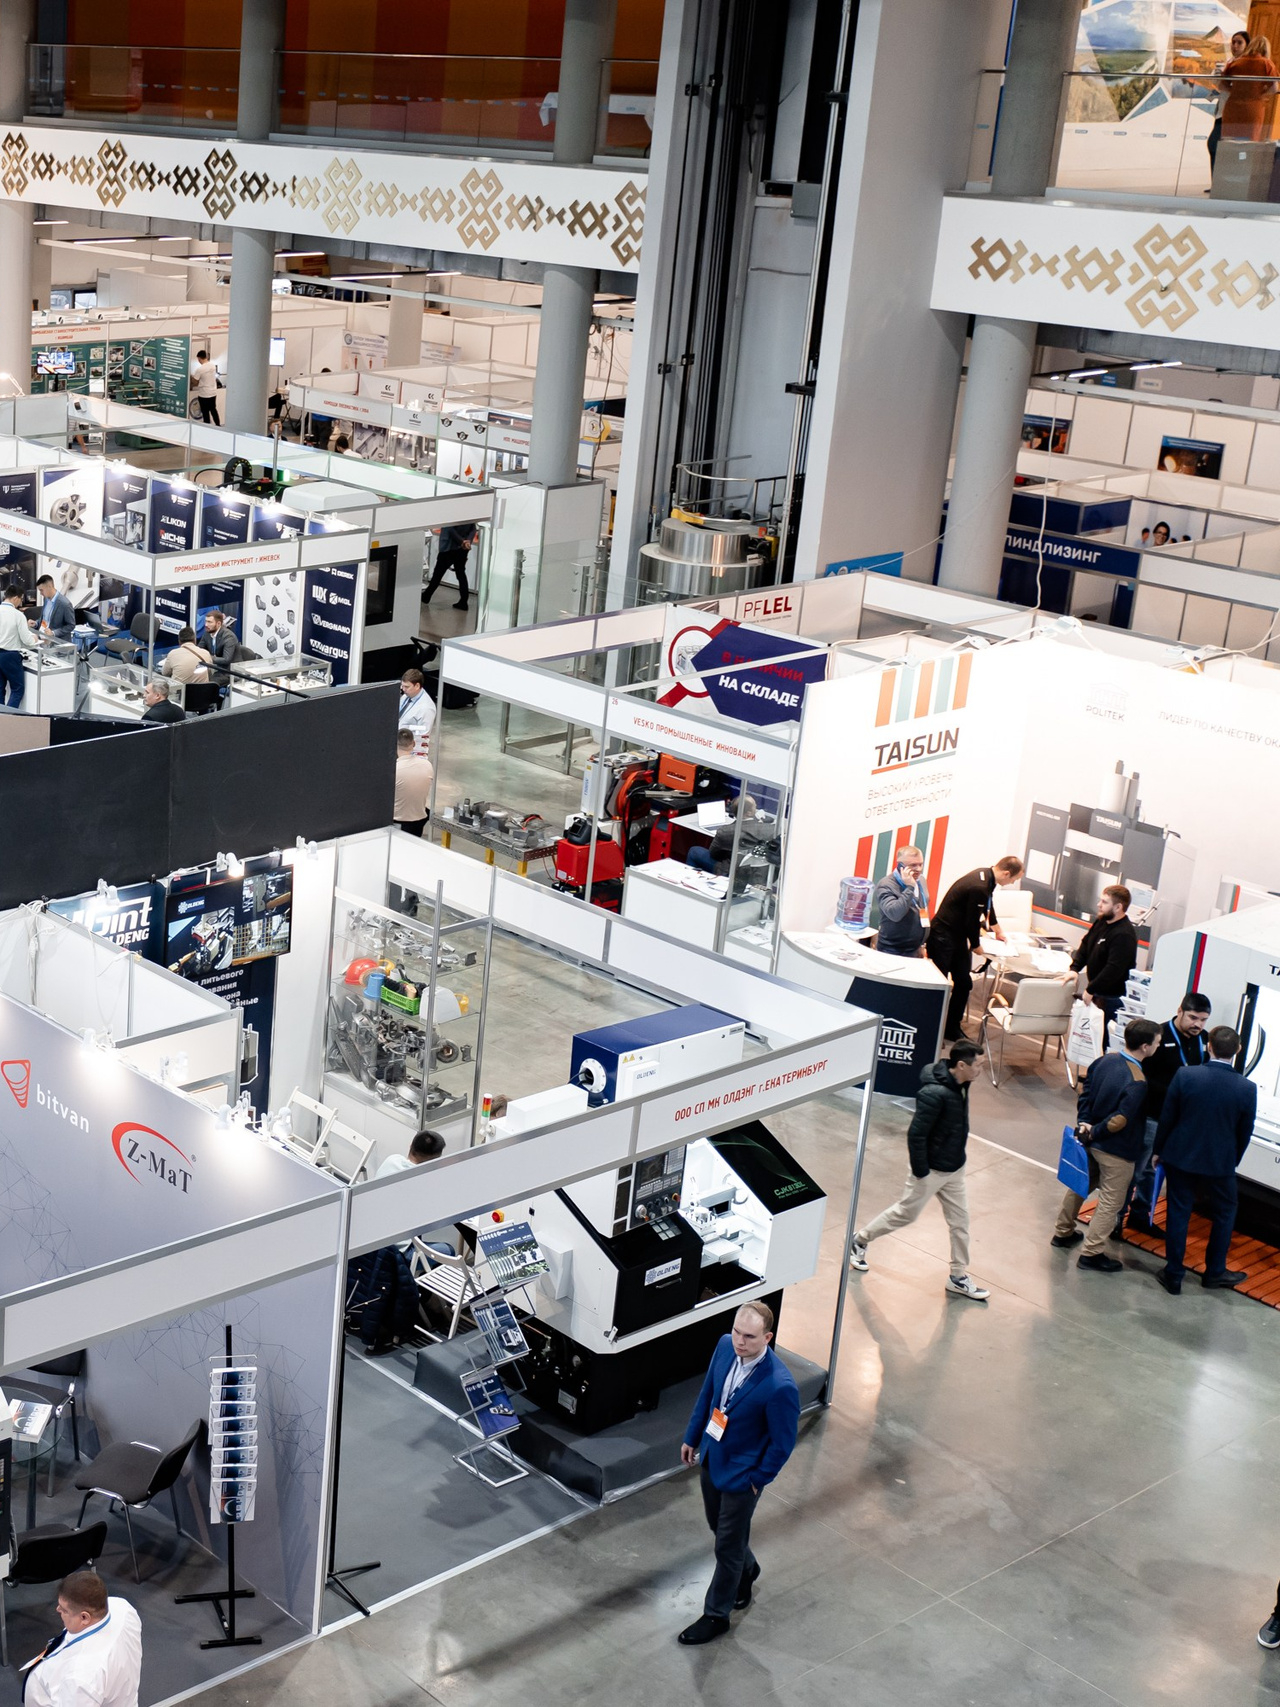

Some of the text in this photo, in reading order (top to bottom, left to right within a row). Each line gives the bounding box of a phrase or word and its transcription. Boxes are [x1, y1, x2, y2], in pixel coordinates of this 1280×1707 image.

[174, 561, 220, 574] ПРОМЫШЛЕННЫЙ
[221, 556, 254, 567] ИНСТРУМЕНТ
[743, 596, 793, 619] PFLEL
[718, 675, 800, 707] НА СКЛАДЕ
[1086, 705, 1126, 722] POLITEK
[1158, 711, 1192, 726] ЛИДЕР
[1193, 719, 1209, 731] ПО
[1210, 724, 1263, 744] КАЧЕСТВУ
[633, 716, 756, 762] VESKO ПРОМЫШЛЕННЫЕ ИННОВАЦИИ
[875, 727, 960, 767] TAISUN
[200, 969, 244, 986] литьевого
[877, 1046, 914, 1061] LITEK
[674, 1059, 829, 1122] ООО СП МК ОЛДЭНГ г.ЕКАТЕРИНБУРГ
[36, 1083, 193, 1194] bitvan Z-MaT
